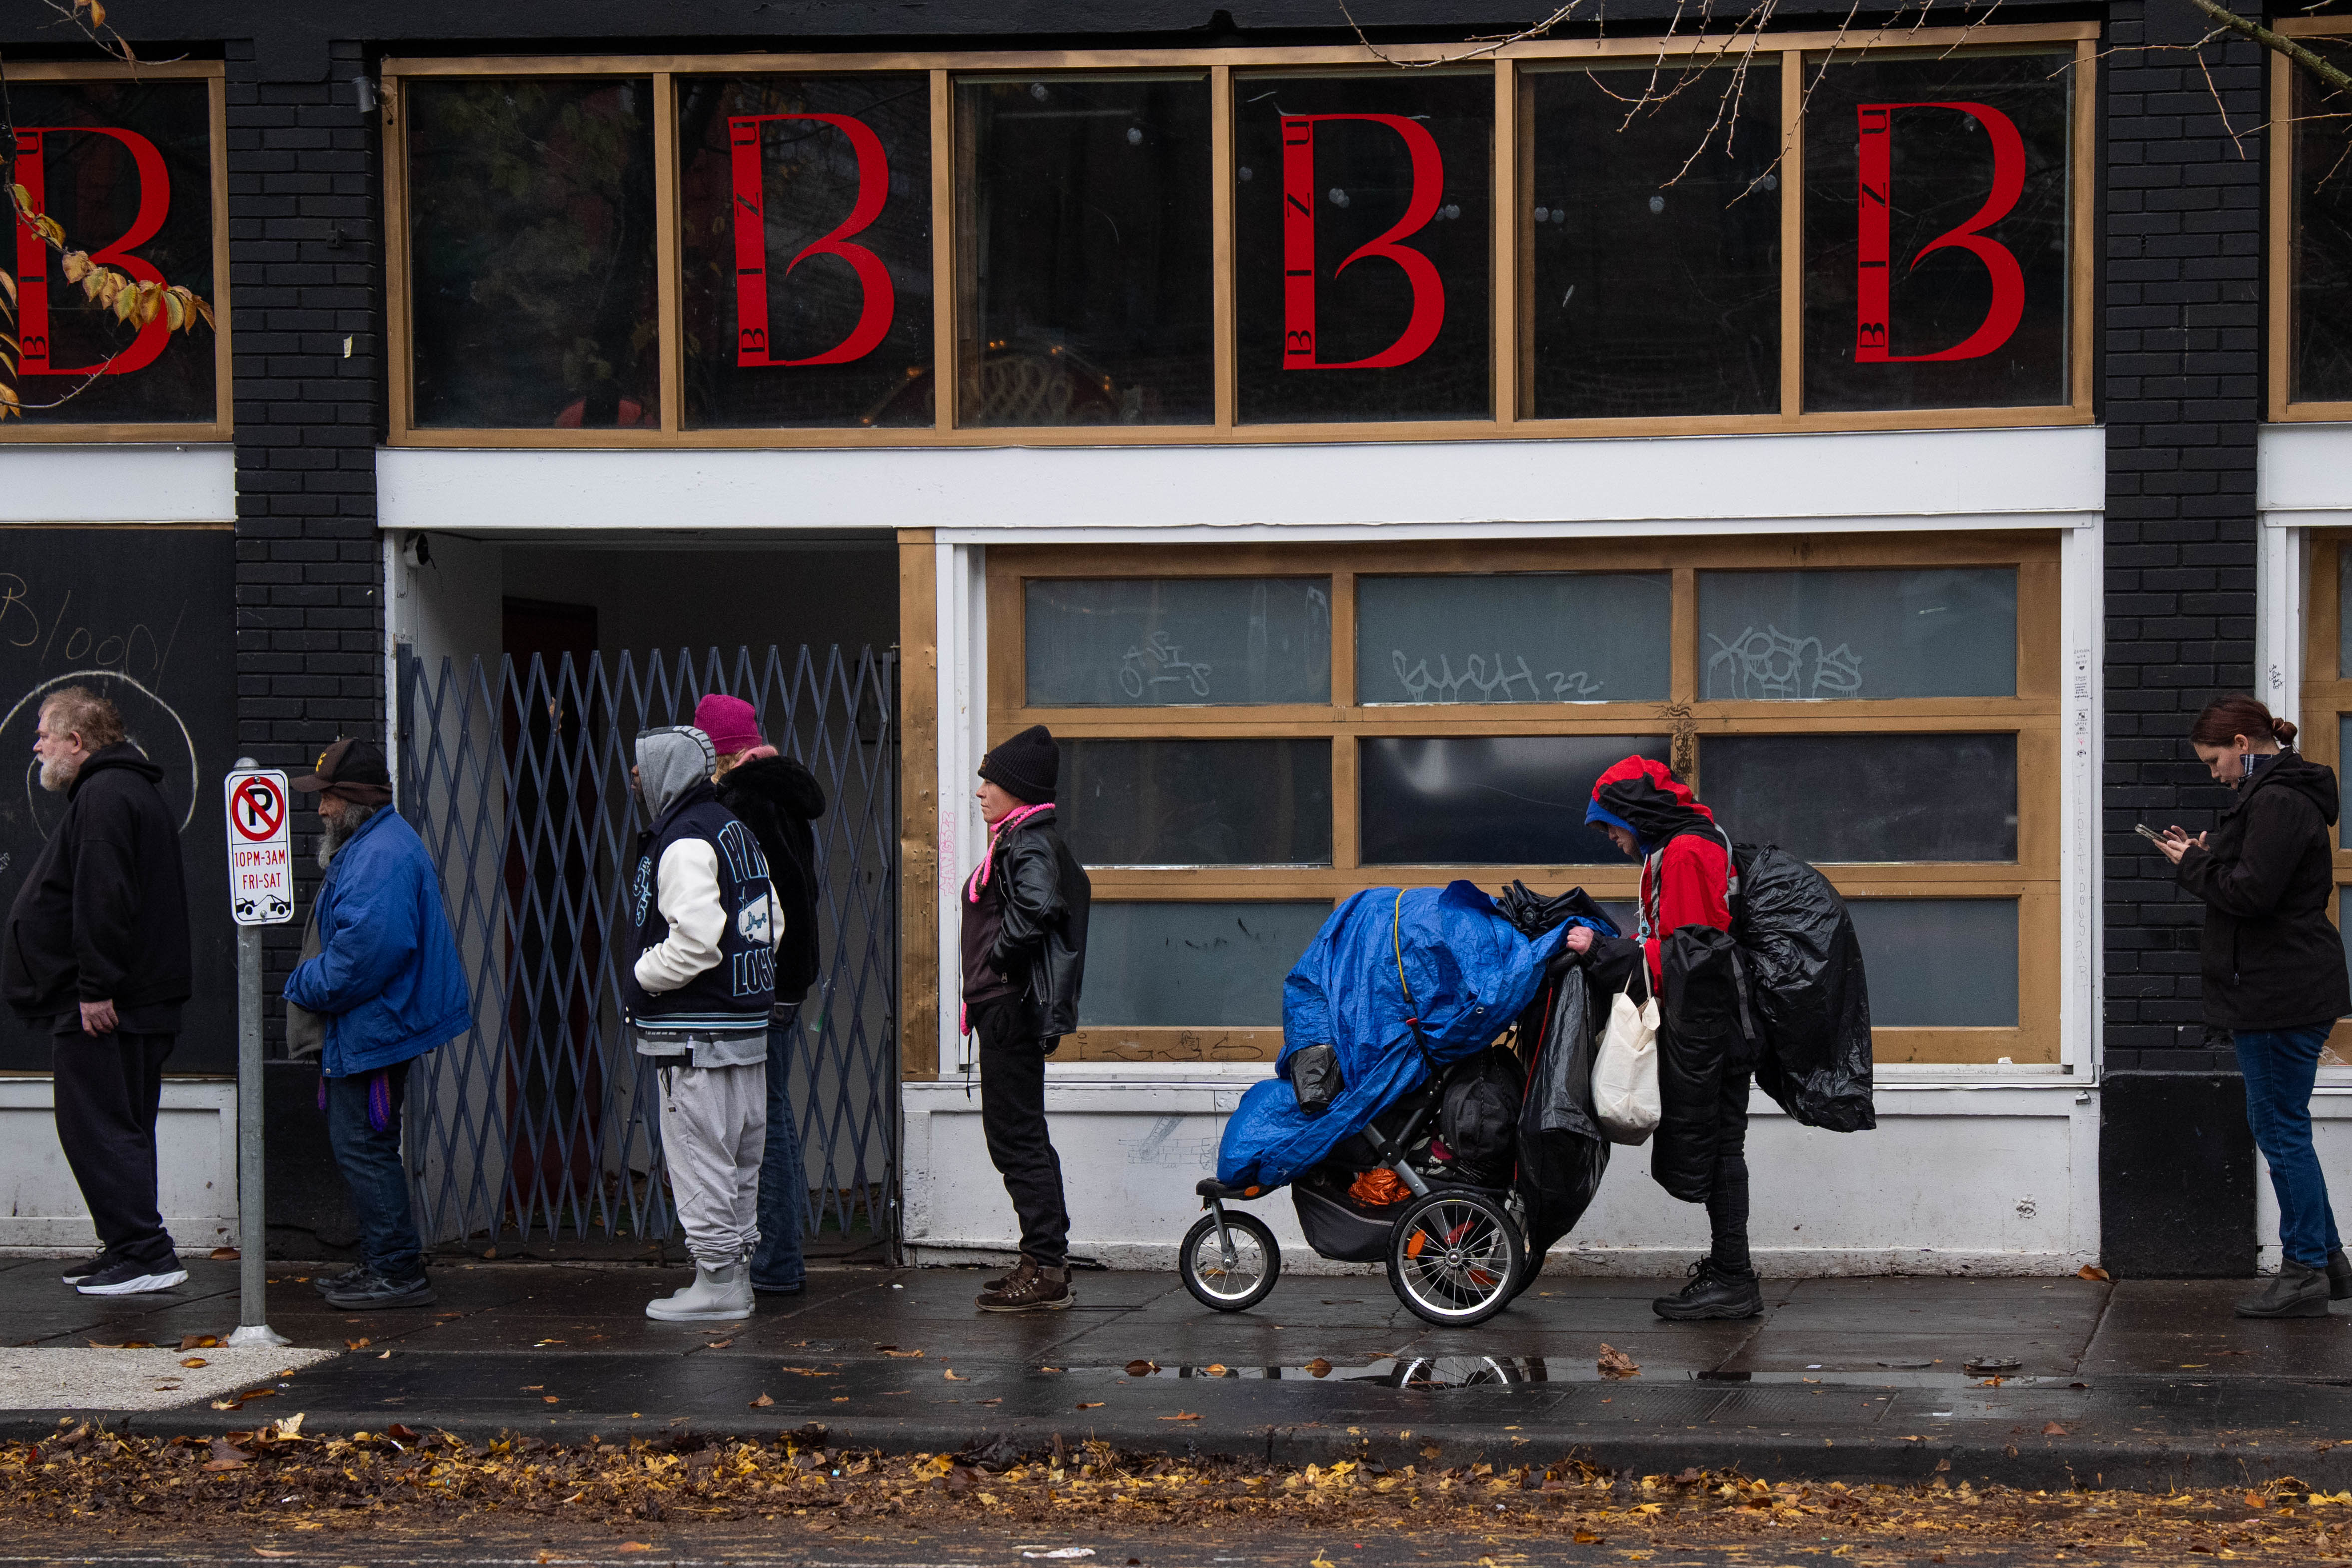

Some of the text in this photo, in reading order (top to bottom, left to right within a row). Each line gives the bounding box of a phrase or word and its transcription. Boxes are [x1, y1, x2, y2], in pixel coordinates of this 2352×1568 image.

[13, 127, 171, 375] B
[14, 131, 46, 360] BIU
[728, 113, 894, 367] B
[732, 121, 766, 353] BIZU
[1280, 113, 1445, 370] B
[1285, 121, 1312, 356] BIZU
[1855, 102, 2026, 363] B
[1859, 109, 1888, 348] BIZU
[235, 849, 285, 867] 10PM-3AM
[243, 873, 281, 889] FRI-SAT
